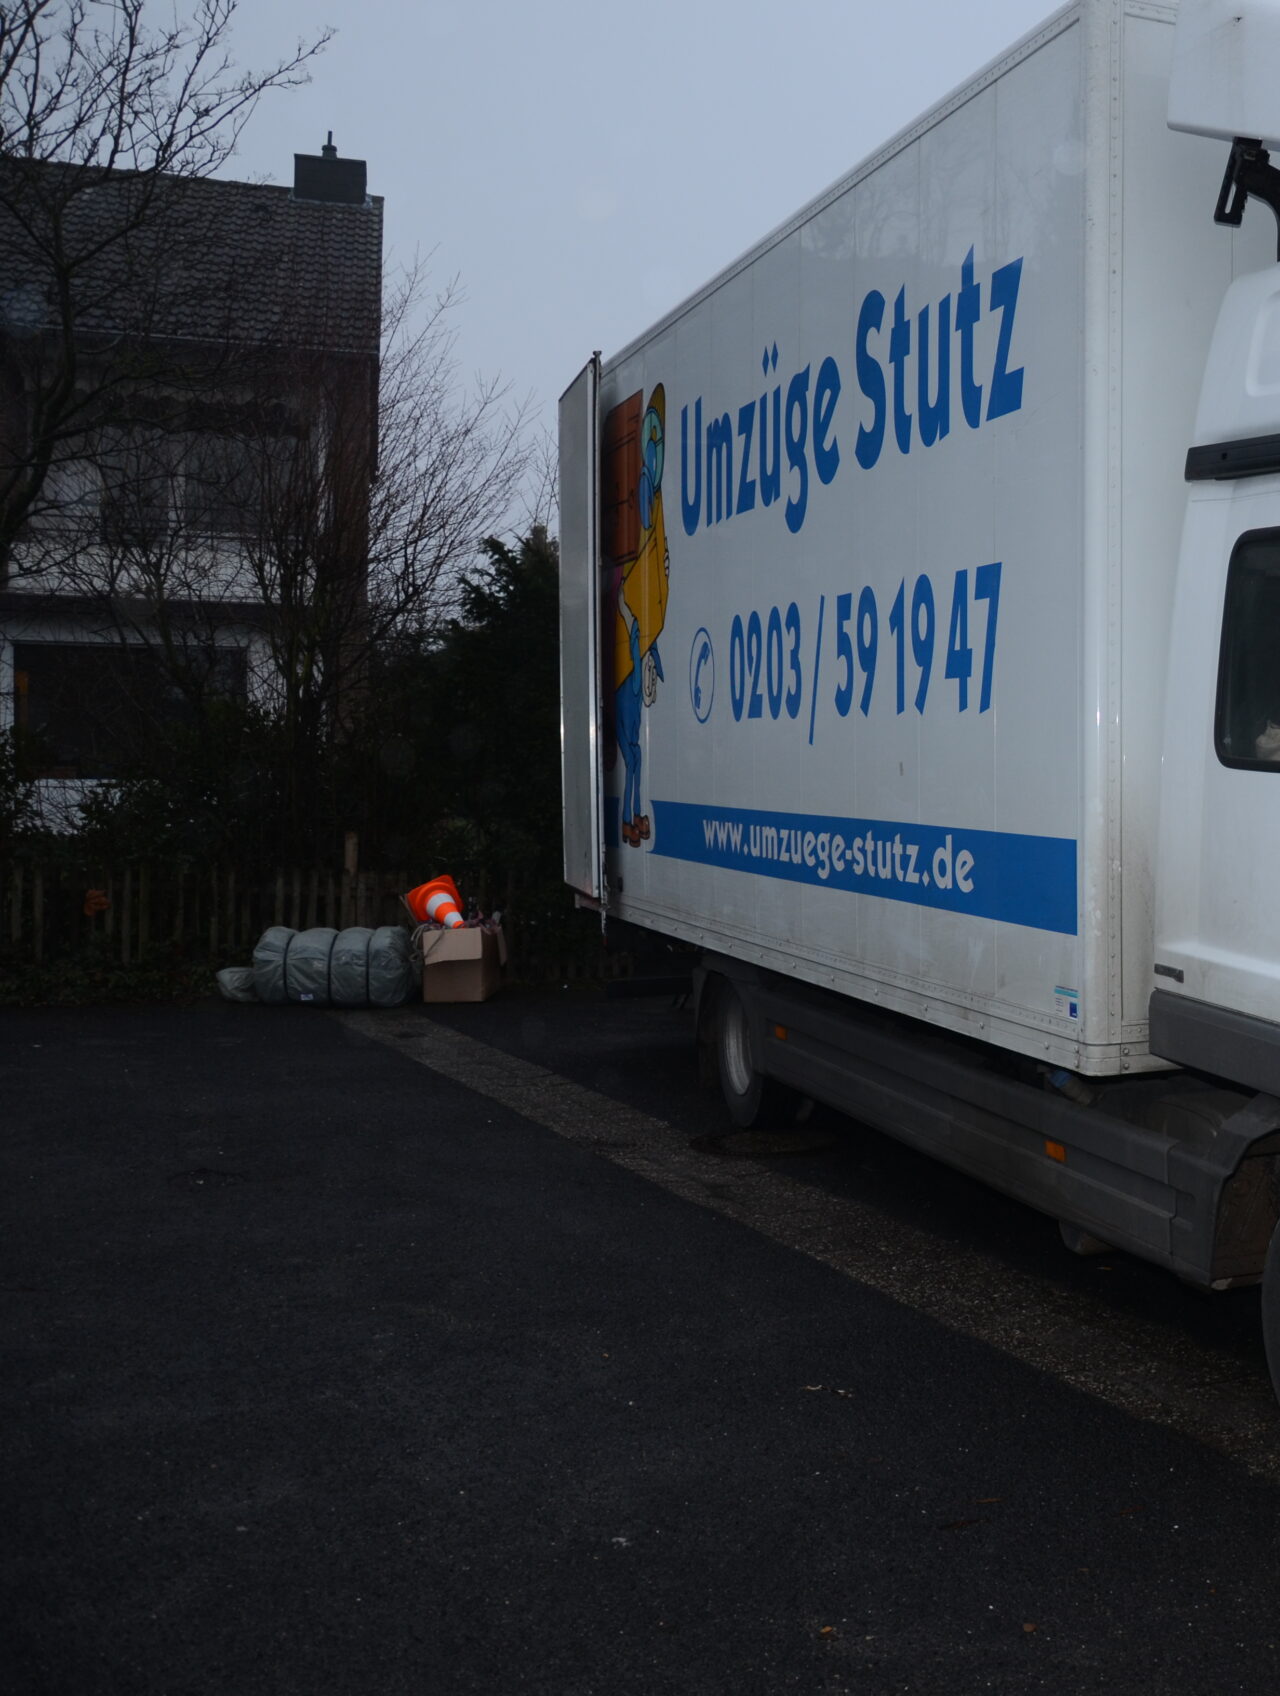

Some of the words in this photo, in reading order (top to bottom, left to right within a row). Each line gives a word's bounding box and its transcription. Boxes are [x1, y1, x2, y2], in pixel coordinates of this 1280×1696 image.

[680, 340, 842, 537] Umzüge
[854, 243, 1025, 471] Stutz
[702, 819, 975, 893] www.umzuege-stutz.de
